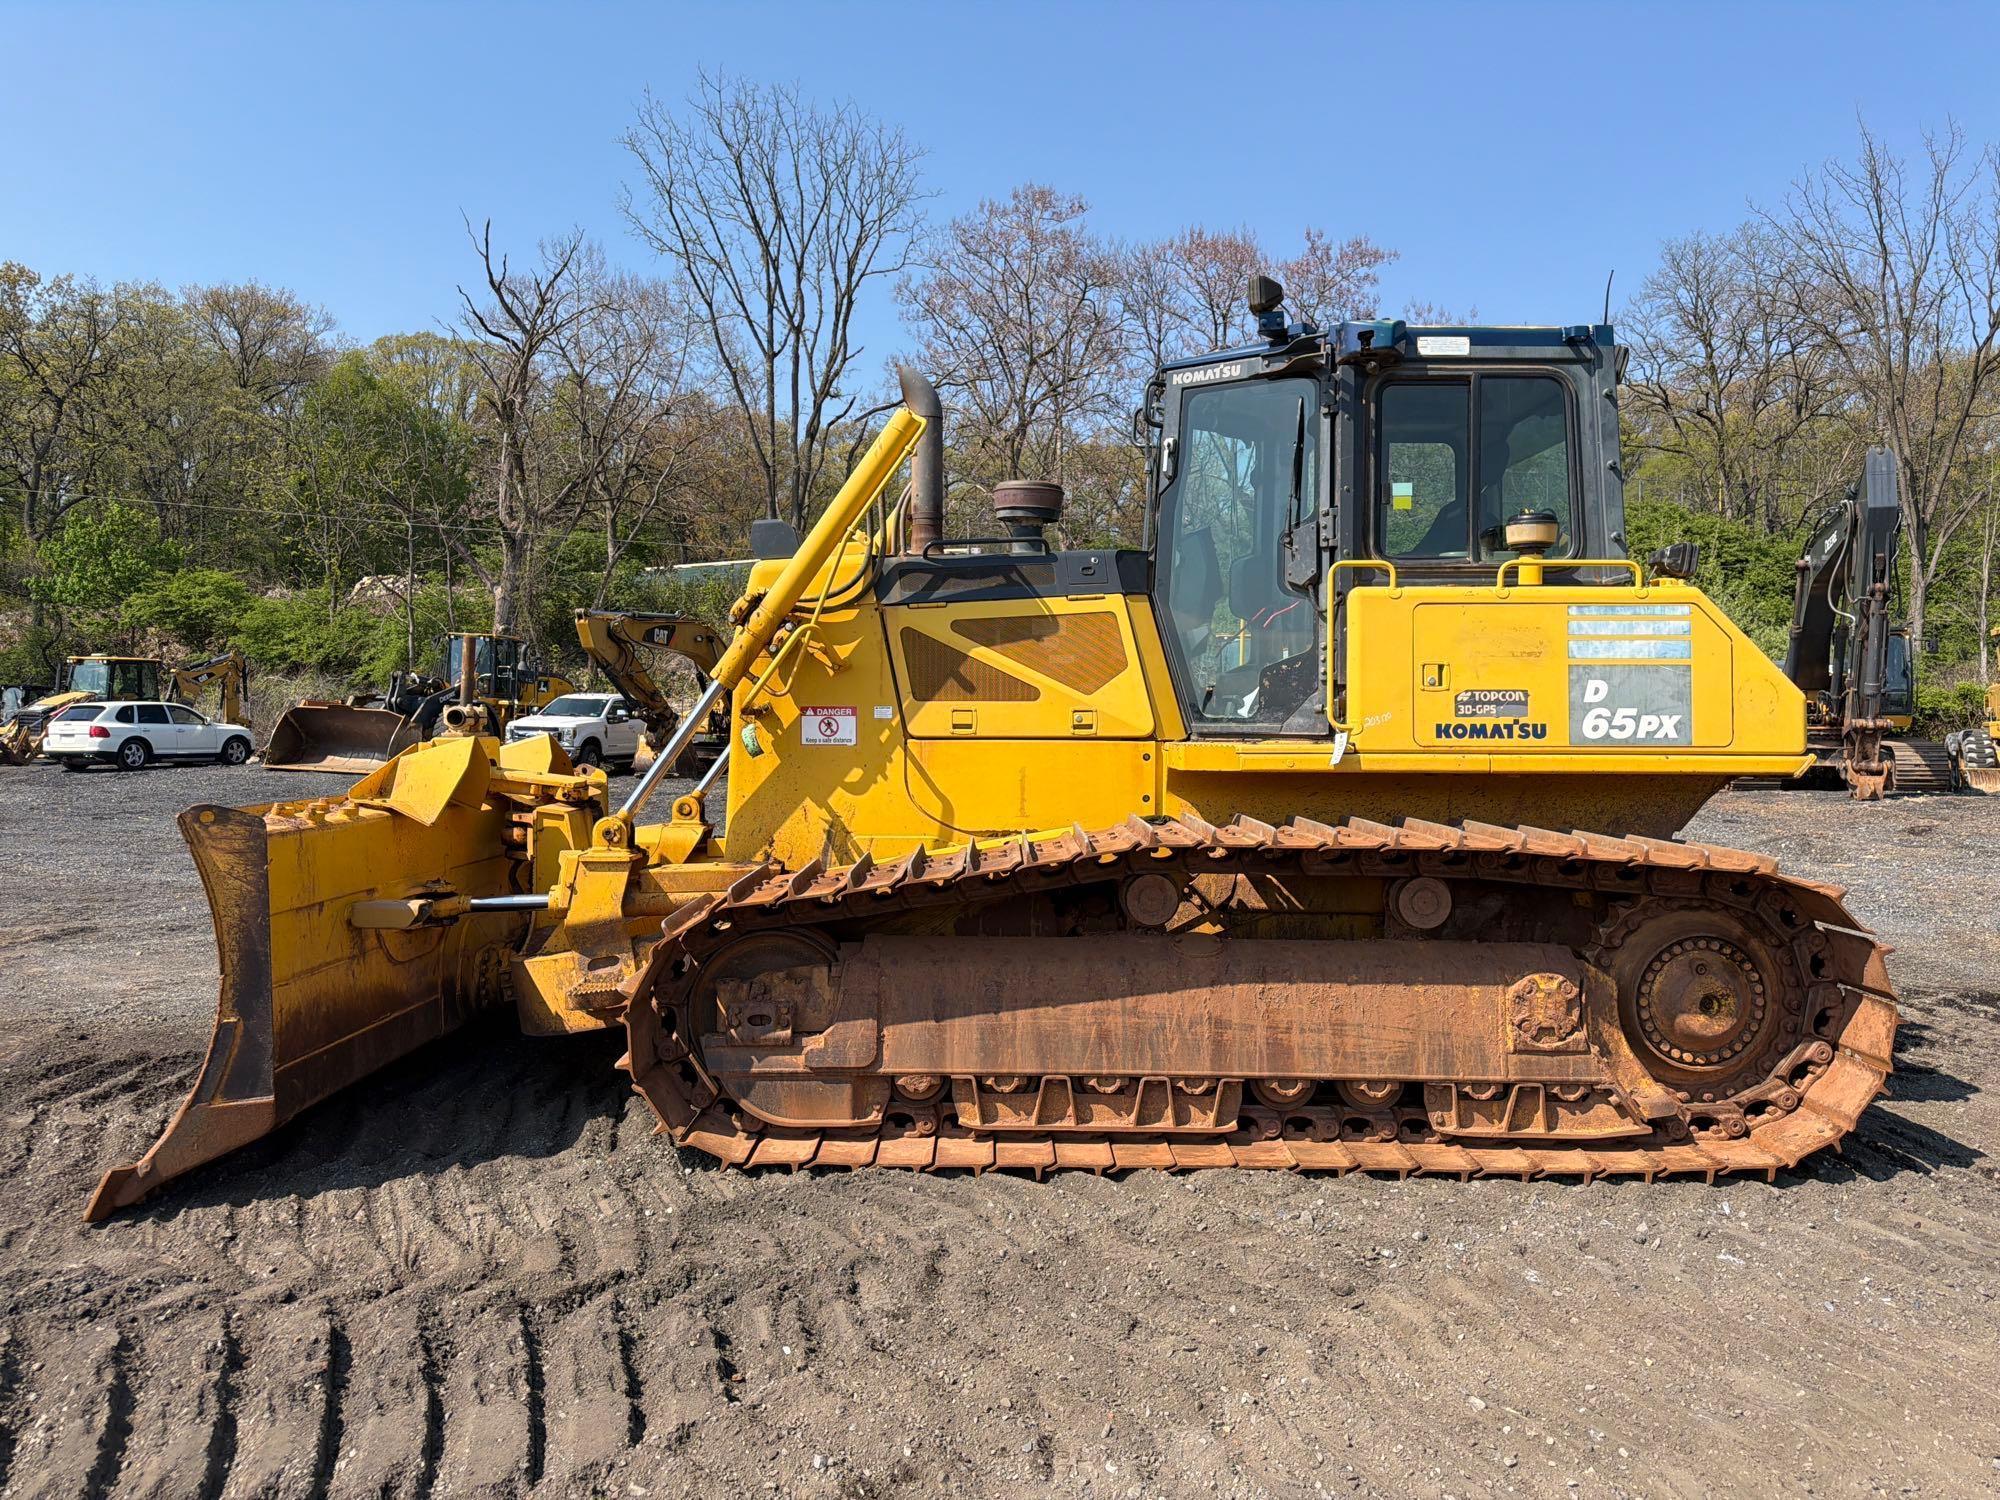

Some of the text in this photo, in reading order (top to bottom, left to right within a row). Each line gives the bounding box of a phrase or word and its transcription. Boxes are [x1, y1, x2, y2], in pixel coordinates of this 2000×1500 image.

[1172, 364, 1241, 385] KOMATSU
[654, 628, 669, 644] CAT
[1473, 691, 1526, 701] TOPCON
[1583, 679, 1609, 703] D
[816, 708, 852, 716] DANGER
[1457, 704, 1497, 715] 3D-GPS
[1435, 718, 1547, 739] KOMATSU
[1582, 707, 1682, 739] 65PX
